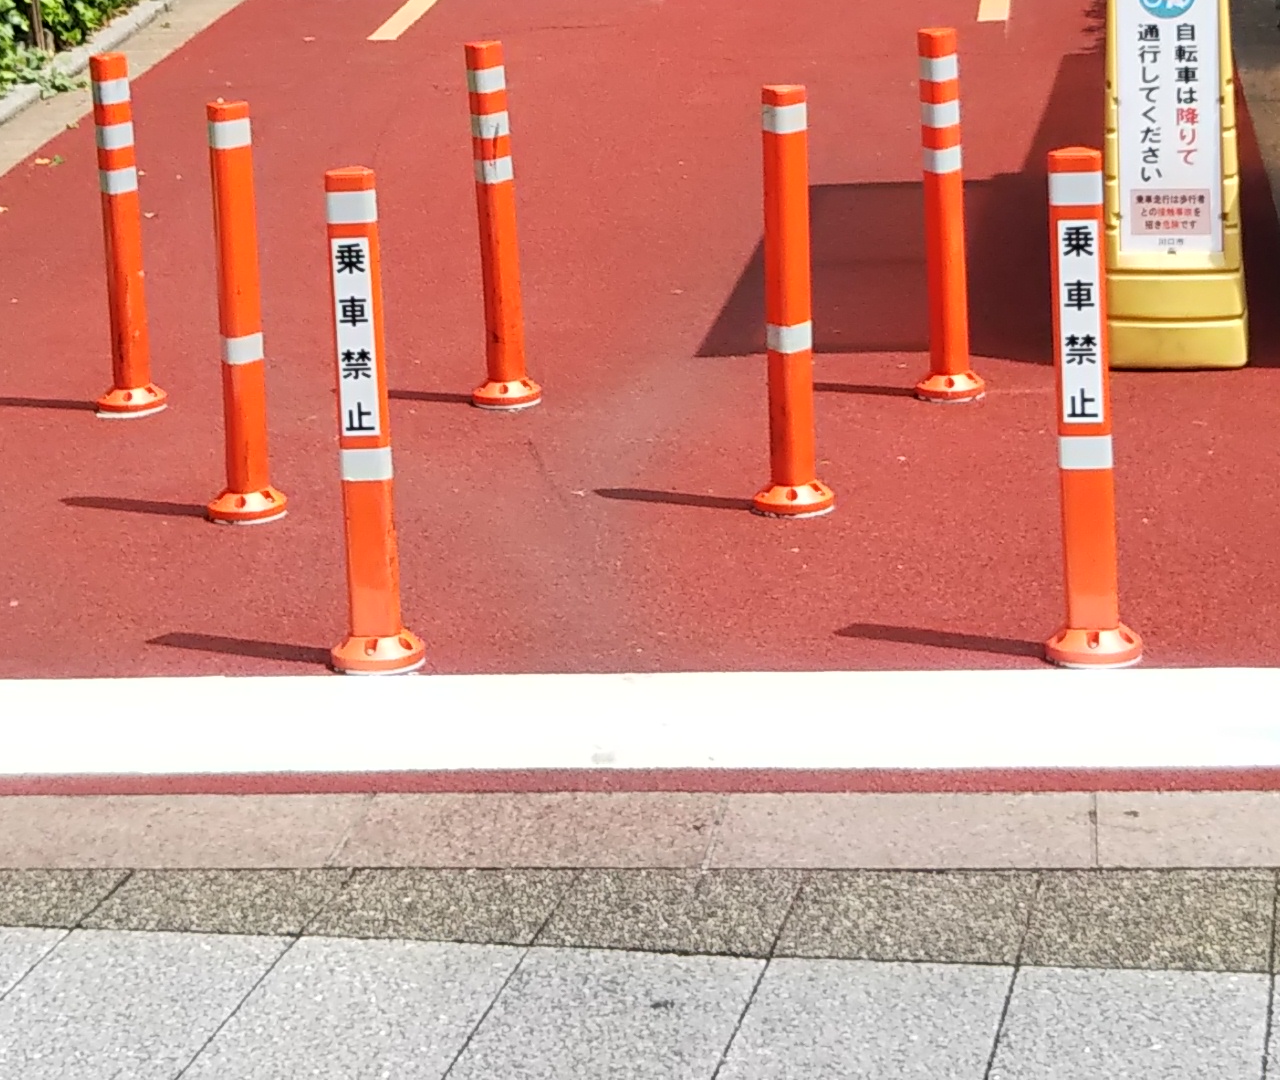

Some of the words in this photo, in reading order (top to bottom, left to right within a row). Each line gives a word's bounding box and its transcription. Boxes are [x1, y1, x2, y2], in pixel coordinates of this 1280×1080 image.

[1137, 24, 1163, 183] 通行してください
[1174, 23, 1199, 166] 自転車は降りて
[335, 243, 376, 432] 乗車禁止
[1062, 225, 1099, 418] 乗車禁止
